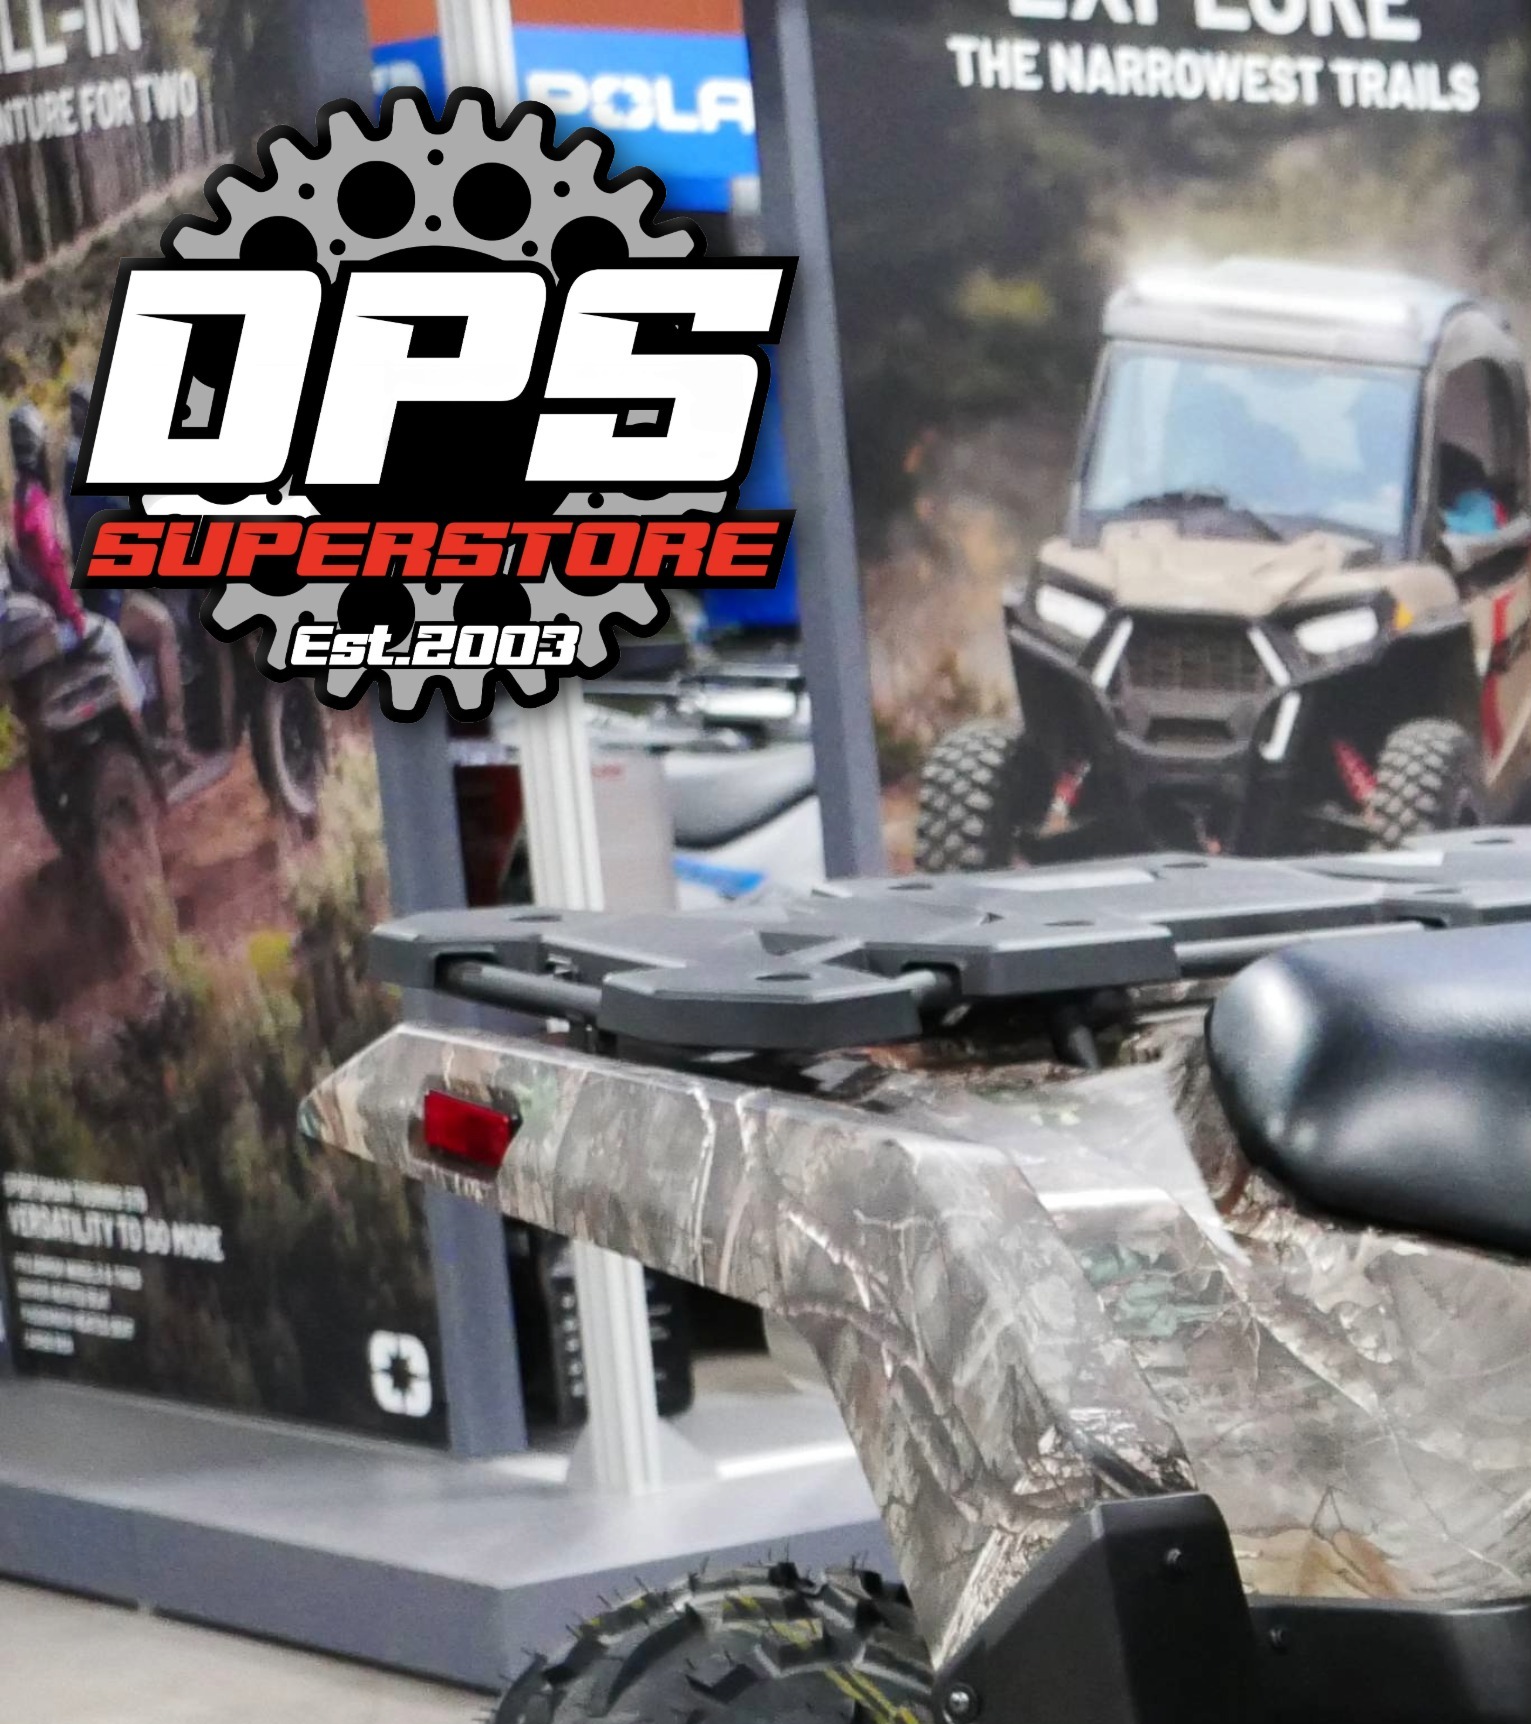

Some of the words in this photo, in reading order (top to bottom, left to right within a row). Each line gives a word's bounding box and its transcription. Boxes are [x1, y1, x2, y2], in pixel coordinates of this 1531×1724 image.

[0, 0, 142, 73] LL-IN
[946, 34, 1043, 91] THE
[1047, 42, 1325, 106] NARROWEST
[1328, 58, 1480, 112] TRAILS
[78, 77, 135, 133] FOR
[133, 68, 198, 123] TWO
